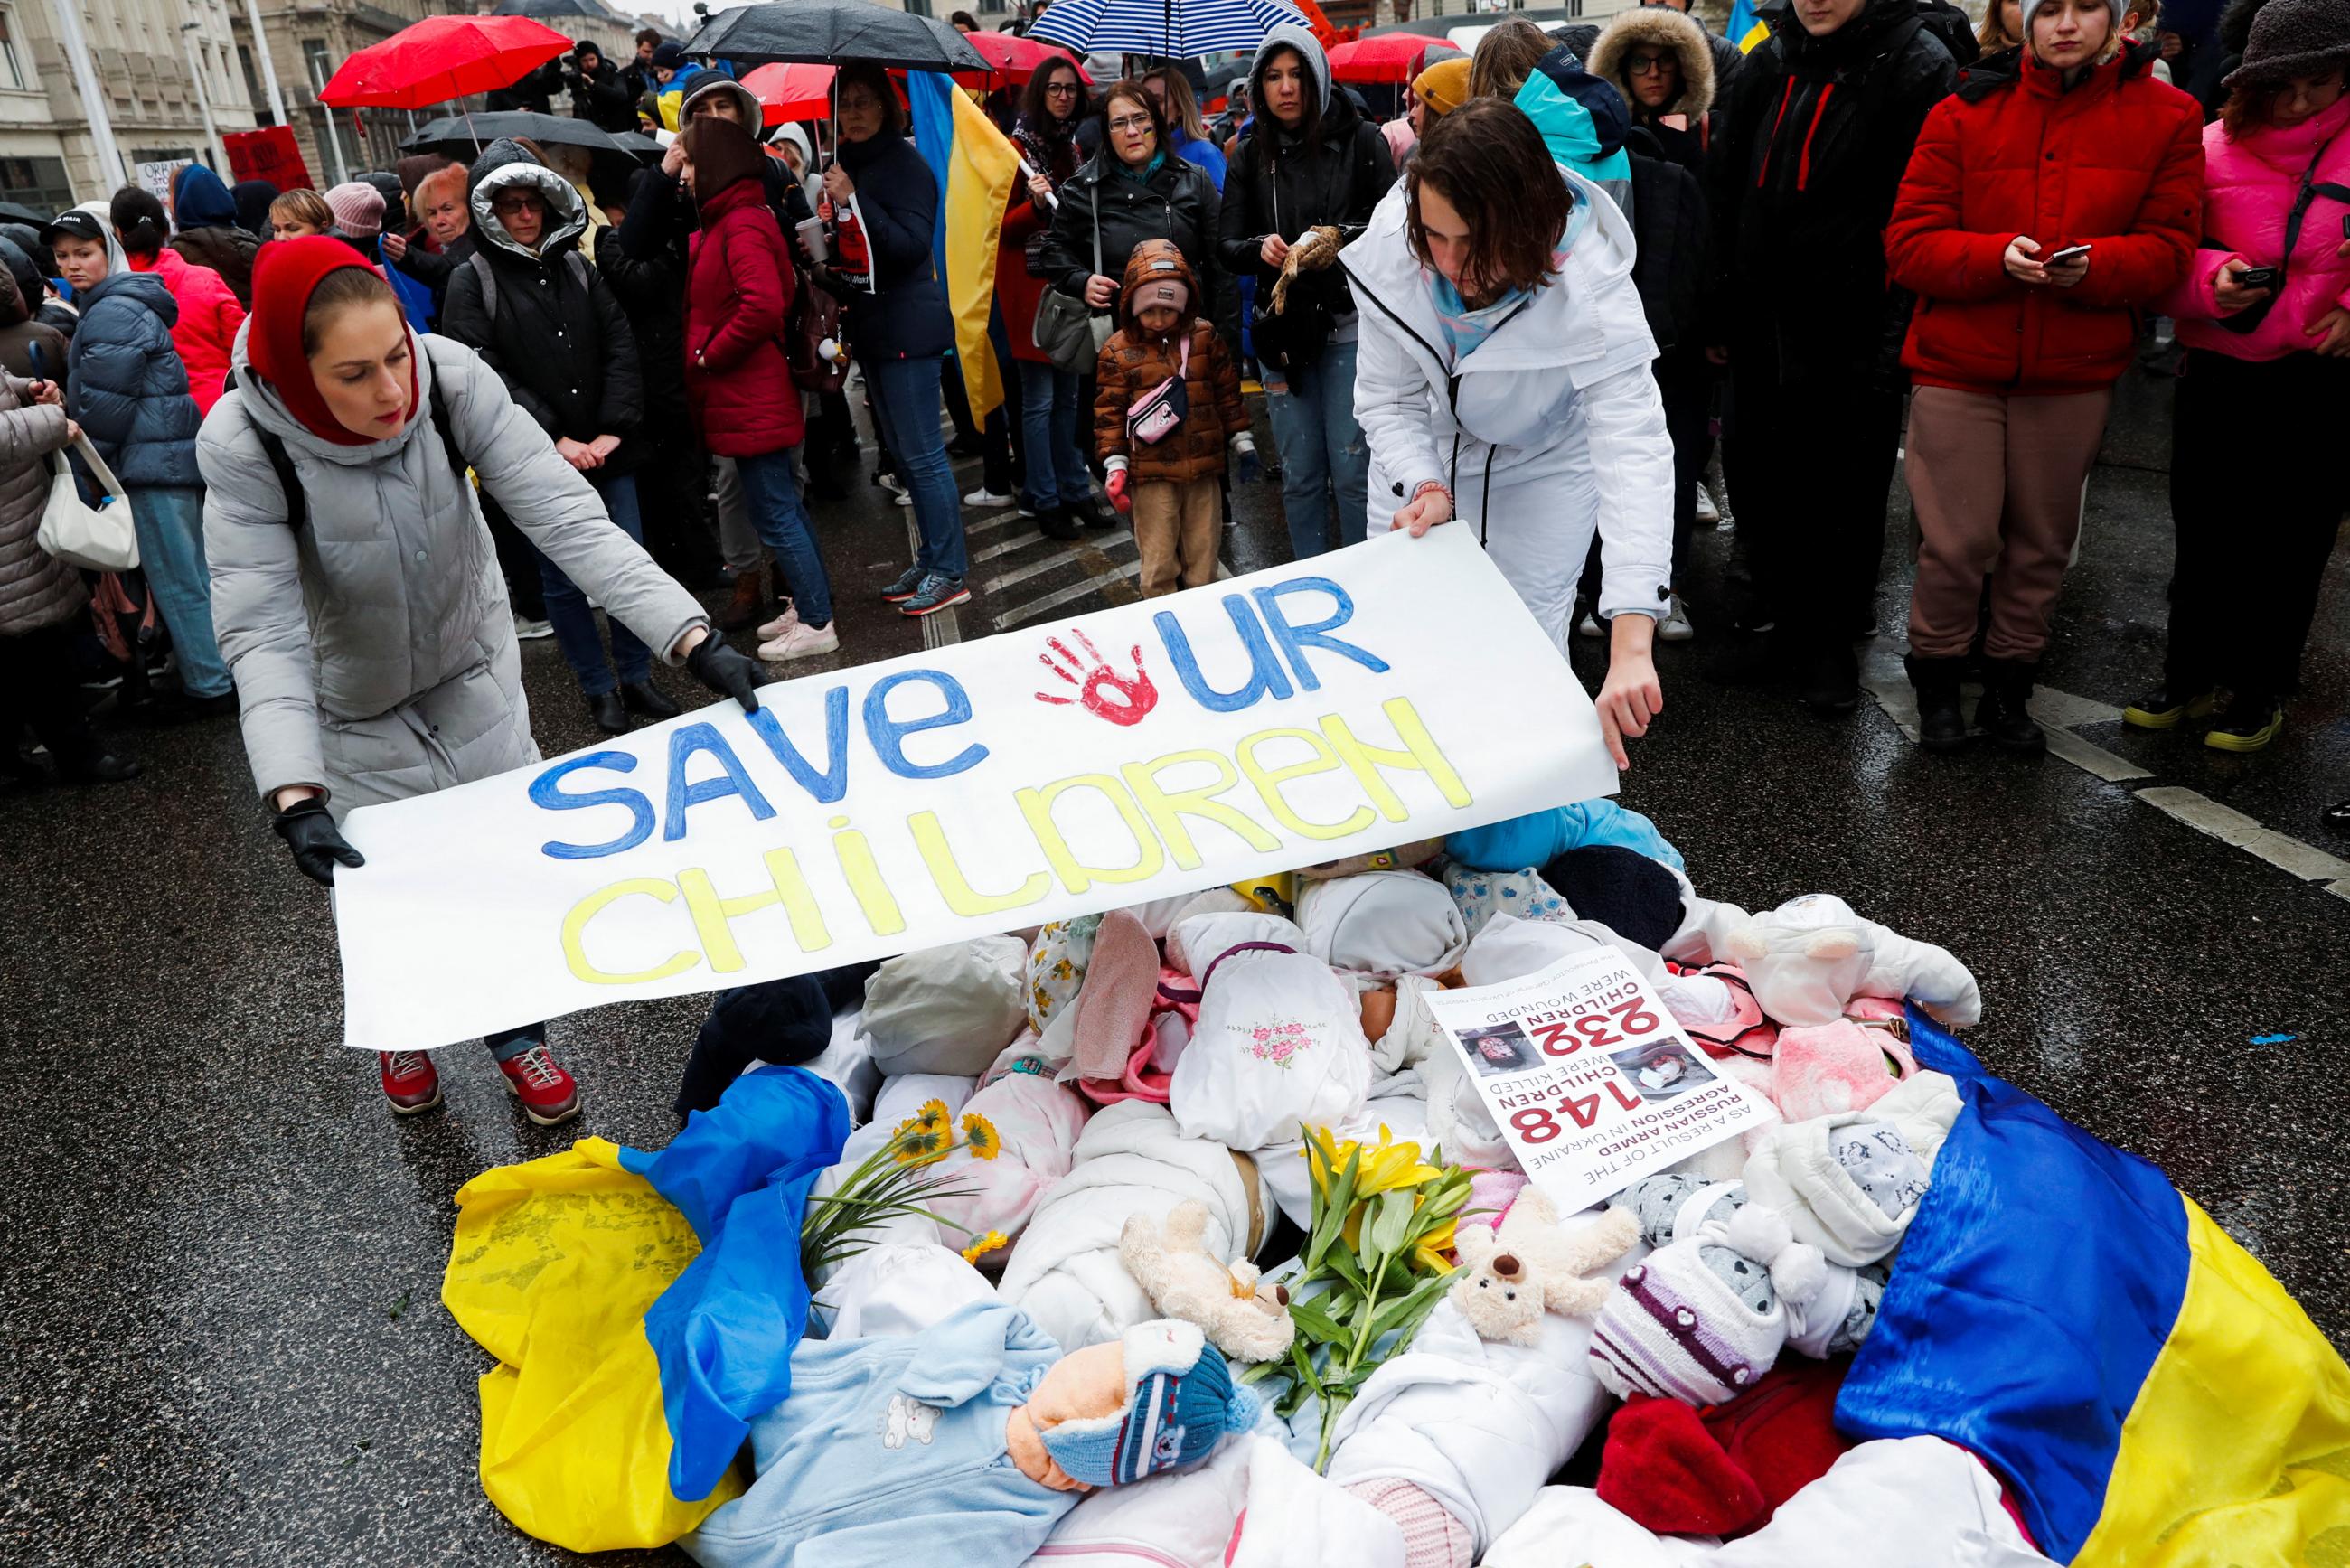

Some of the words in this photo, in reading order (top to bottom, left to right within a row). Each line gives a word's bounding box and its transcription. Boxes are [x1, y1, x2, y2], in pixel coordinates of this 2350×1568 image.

[153, 177, 168, 186] STO
[1580, 969, 1631, 997] WERE
[1486, 991, 1579, 1023] WOUNDED
[1526, 981, 1639, 1026] CHILDREN
[1529, 995, 1660, 1056] 232
[1556, 1055, 1609, 1077] WERE
[1490, 1073, 1553, 1095] KILLED
[1498, 1066, 1617, 1110] CHILDREN
[1509, 1080, 1643, 1144] 148
[1631, 1084, 1729, 1128] AGRESSION
[1664, 1094, 1742, 1131] RUSSIAN
[1713, 1114, 1725, 1125] A
[1729, 1104, 1751, 1120] AS
[1599, 1126, 1659, 1157] ARMED
[1609, 1123, 1629, 1138] IN
[1651, 1122, 1713, 1155] RESULT
[1529, 1133, 1607, 1170] UKRAINE
[1624, 1150, 1646, 1167] OF
[1584, 1161, 1622, 1185] THE
